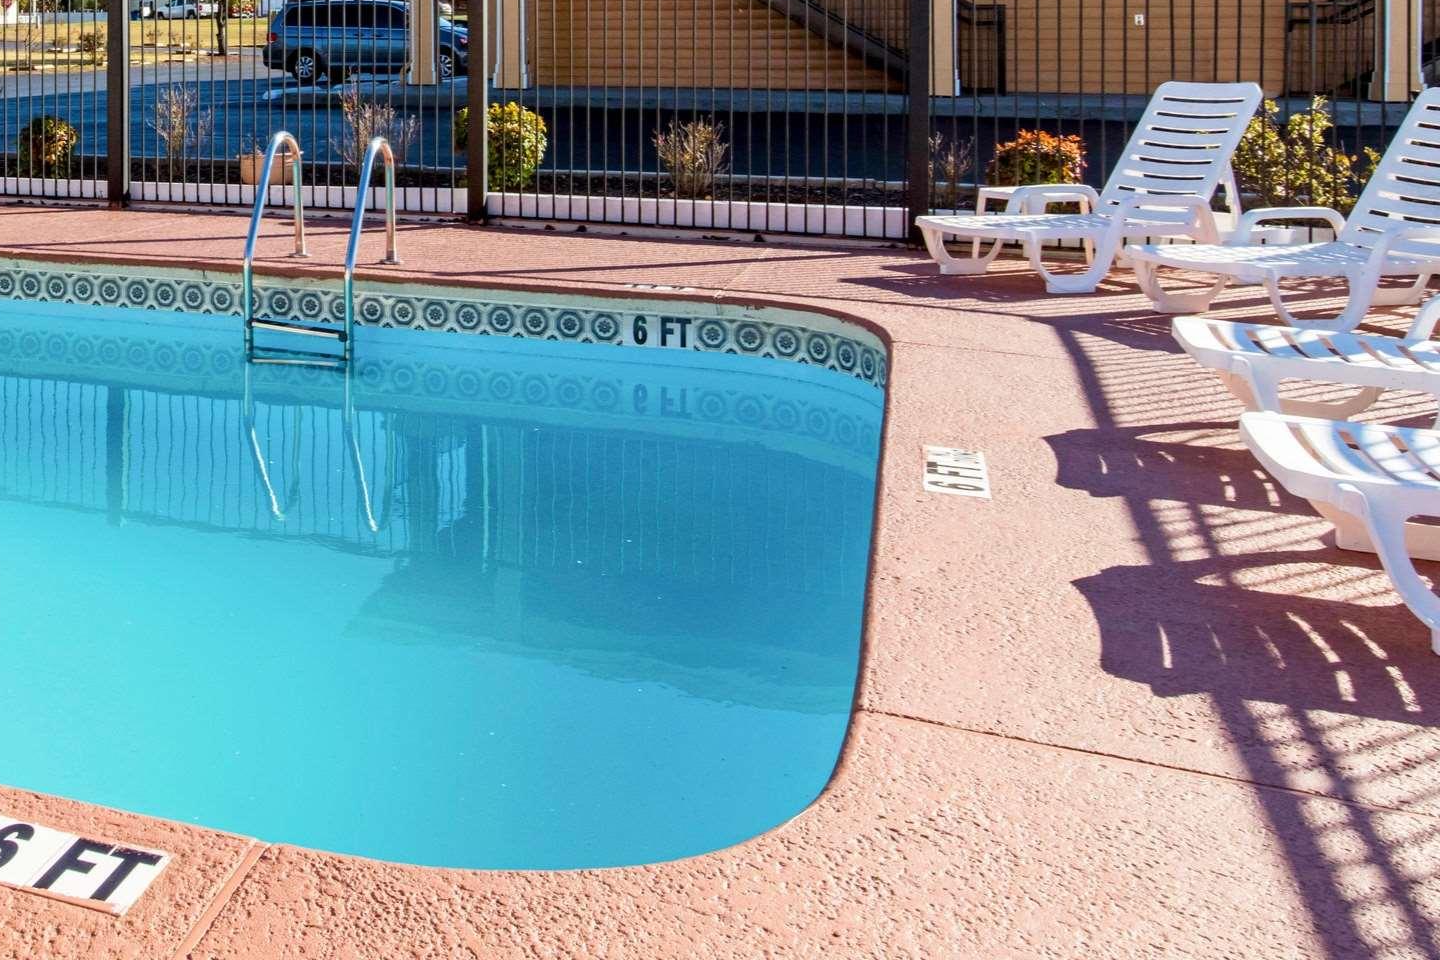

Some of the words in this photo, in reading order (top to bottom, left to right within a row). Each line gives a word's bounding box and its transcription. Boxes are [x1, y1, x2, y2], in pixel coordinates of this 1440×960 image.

[633, 315, 648, 345] 6
[661, 316, 692, 348] FT
[926, 461, 983, 479] FT
[927, 481, 985, 491] 6
[31, 837, 164, 901] FT
